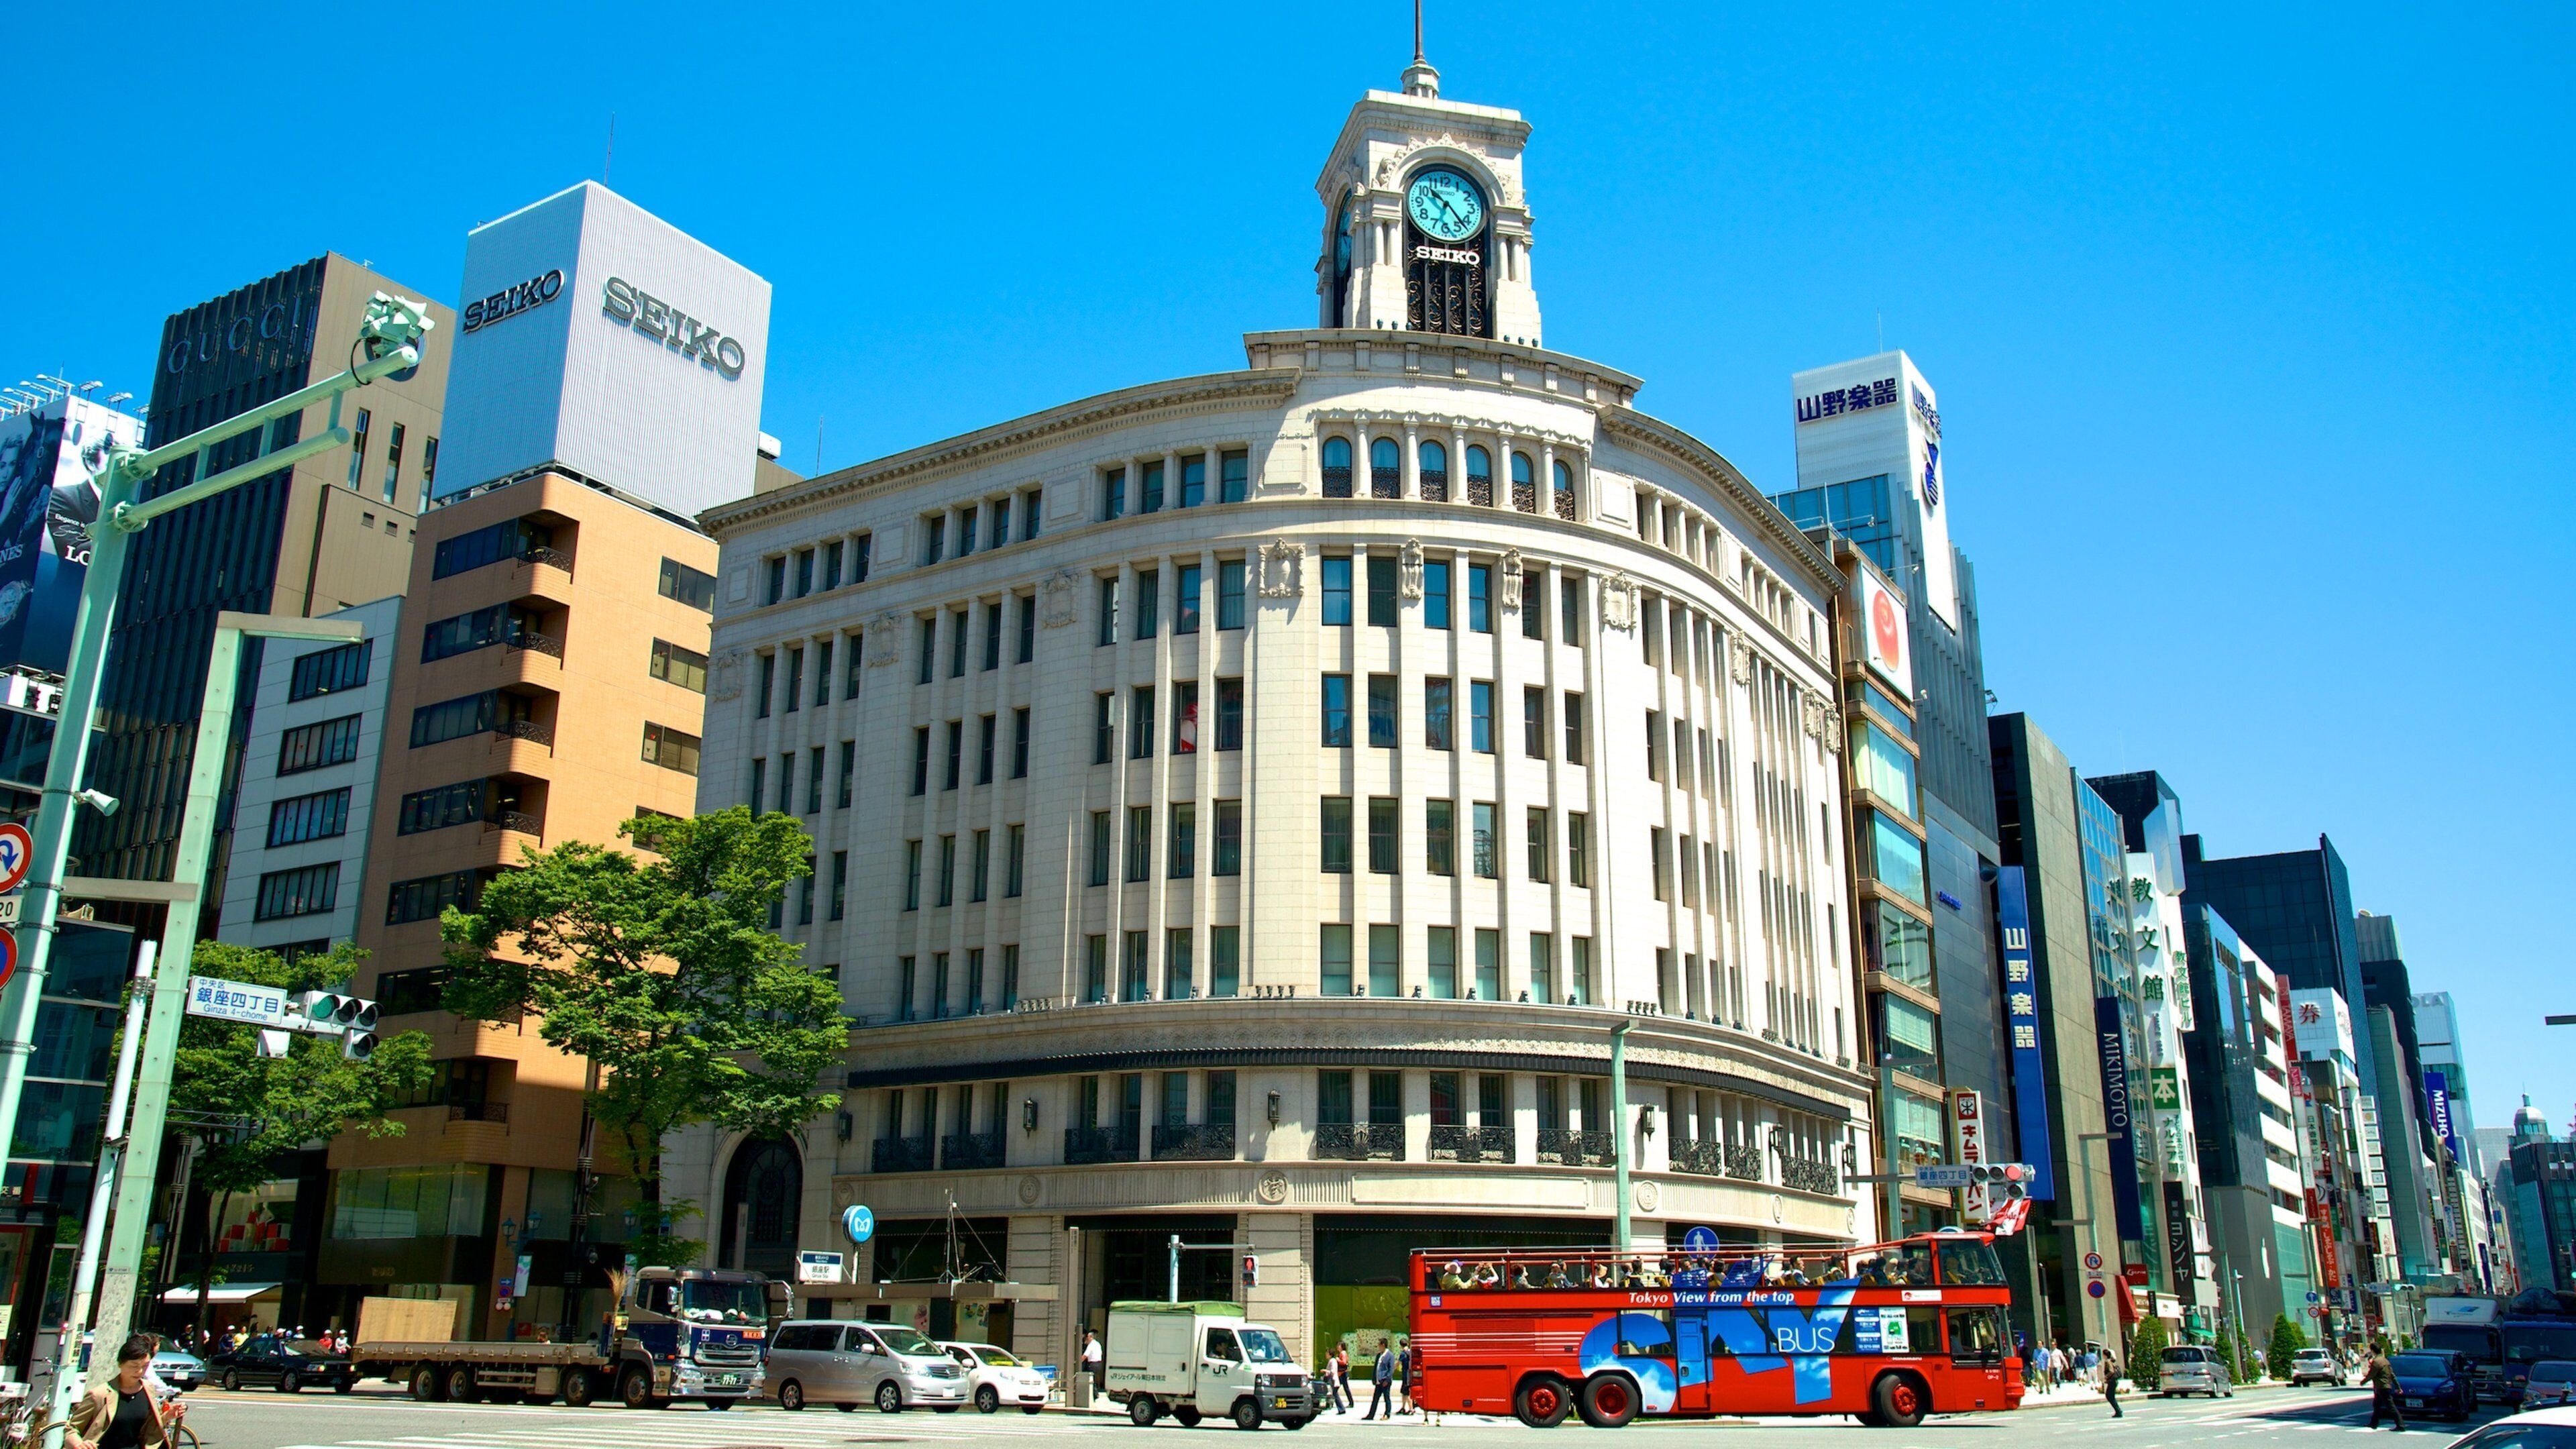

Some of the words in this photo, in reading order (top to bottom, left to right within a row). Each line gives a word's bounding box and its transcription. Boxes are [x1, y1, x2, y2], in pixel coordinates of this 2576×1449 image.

[1430, 177, 1437, 189] 11
[1440, 176, 1450, 187] 12
[1456, 181, 1459, 193] 1
[1419, 184, 1429, 197] 10
[1463, 191, 1471, 202] 2
[1415, 197, 1424, 207] 9
[1467, 203, 1475, 214] 3
[1419, 208, 1428, 219] 8
[1463, 215, 1472, 225] 4
[1430, 218, 1439, 229] 7
[1441, 223, 1450, 234] 6
[1453, 221, 1462, 232] 5
[1416, 246, 1480, 266] SEIKO
[463, 270, 566, 333] SEIKO
[604, 277, 745, 376] SEIKO
[168, 297, 301, 374] GUCCI
[1797, 378, 1898, 423] 山野楽器
[2131, 877, 2163, 1001] 教文館
[199, 979, 225, 989] 中央区
[2004, 927, 2036, 1049] 山野楽器
[2175, 950, 2192, 1026] 教文館ビル
[197, 987, 279, 1014] 銀座四丁目
[204, 1004, 227, 1015] Ginza
[231, 1008, 268, 1021] 4-chome
[2104, 1032, 2128, 1128] MIKIMOTO
[2153, 1075, 2176, 1104] 本
[2433, 1090, 2449, 1138] MIZUHO
[2163, 1117, 2180, 1174] ナルニア国
[1919, 1171, 1967, 1180] 銀座四丁目
[2171, 1222, 2189, 1282] ヨシノヤ
[1629, 1292, 1668, 1306] Tokyo
[1673, 1291, 1706, 1303] View
[1710, 1291, 1742, 1303] from
[1747, 1291, 1768, 1302] the
[1772, 1291, 1794, 1305] top
[1778, 1327, 1835, 1352] BUS
[1213, 1364, 1228, 1375] JR
